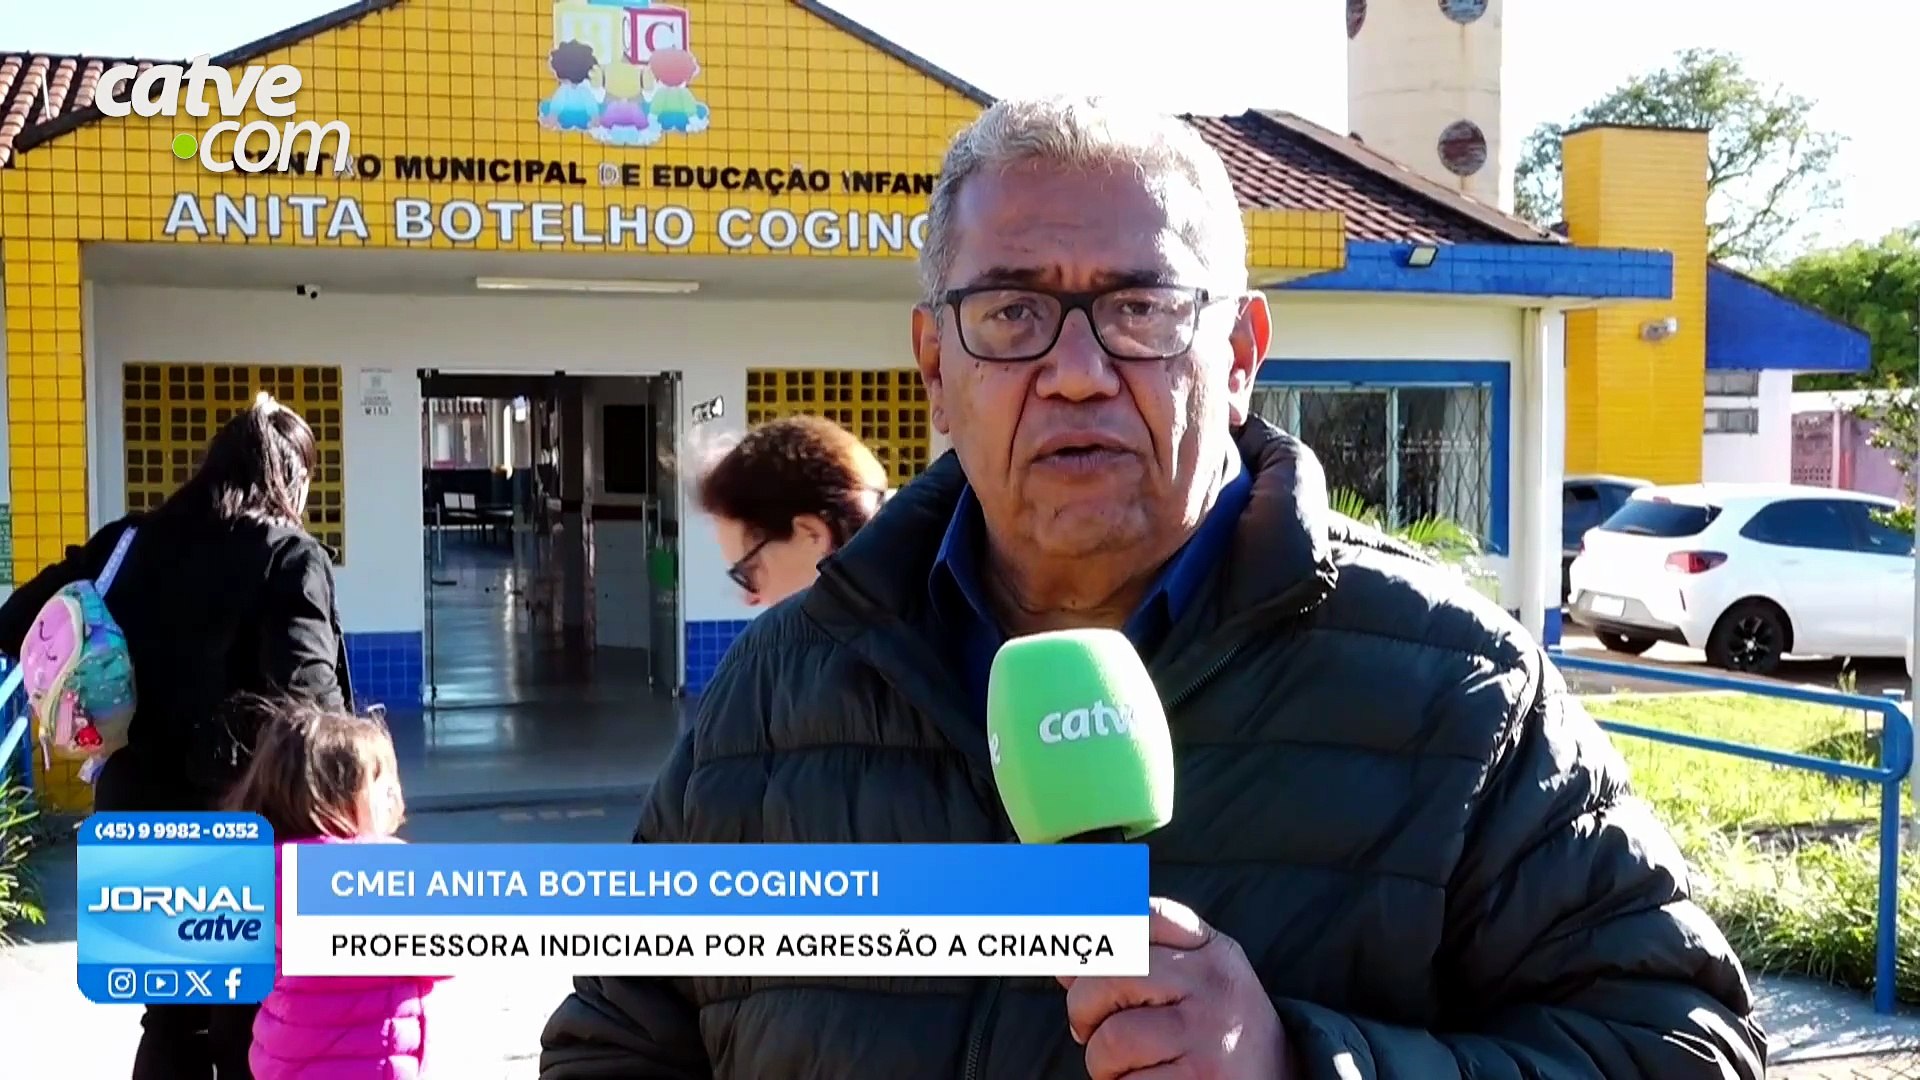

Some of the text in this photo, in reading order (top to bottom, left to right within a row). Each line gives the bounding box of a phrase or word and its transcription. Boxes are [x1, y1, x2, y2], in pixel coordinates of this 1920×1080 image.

[395, 157, 587, 186] MUNICIPAL
[599, 163, 640, 186] DE
[842, 169, 942, 195] INFAN
[162, 192, 930, 252] ANITA BOTELHO COGINO
[1038, 699, 1137, 744] catv
